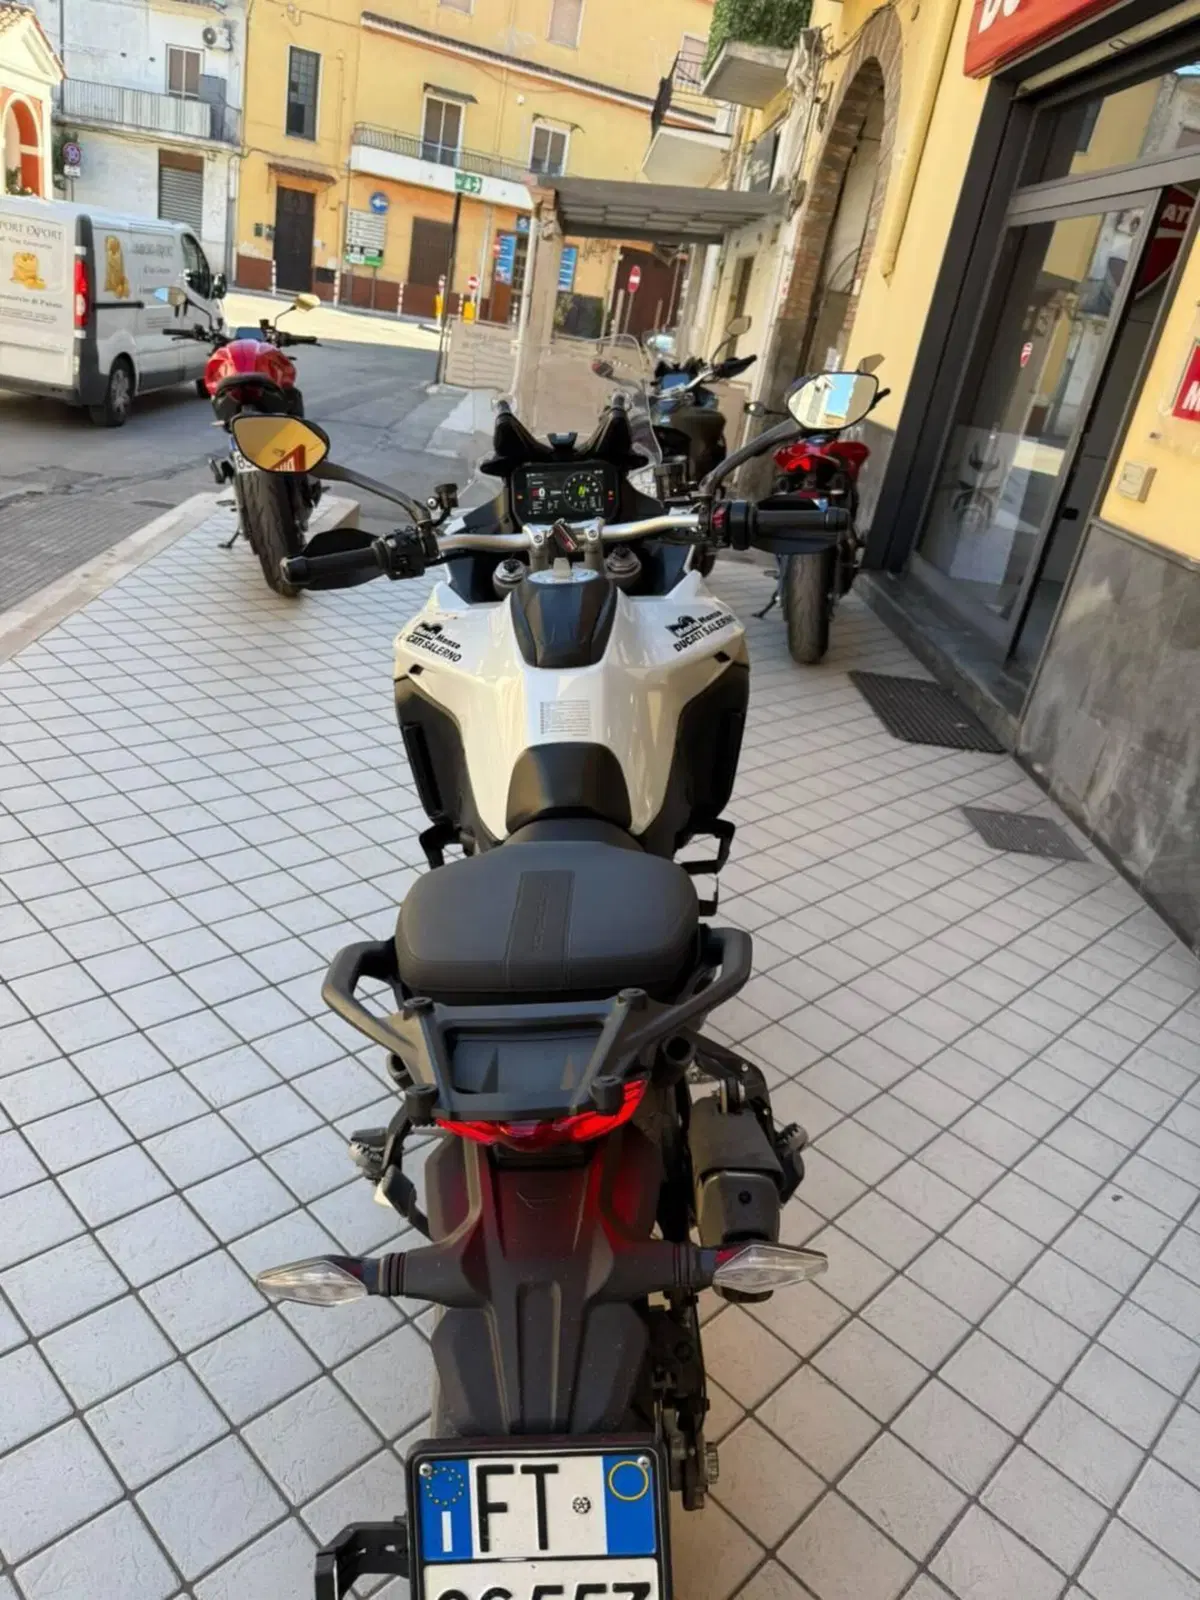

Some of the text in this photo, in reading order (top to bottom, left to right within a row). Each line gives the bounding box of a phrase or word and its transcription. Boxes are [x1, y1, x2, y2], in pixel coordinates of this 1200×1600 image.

[1160, 203, 1192, 224] AT
[422, 641, 462, 662] SALERNO
[673, 631, 704, 652] DUCATI
[476, 1464, 559, 1552] FT
